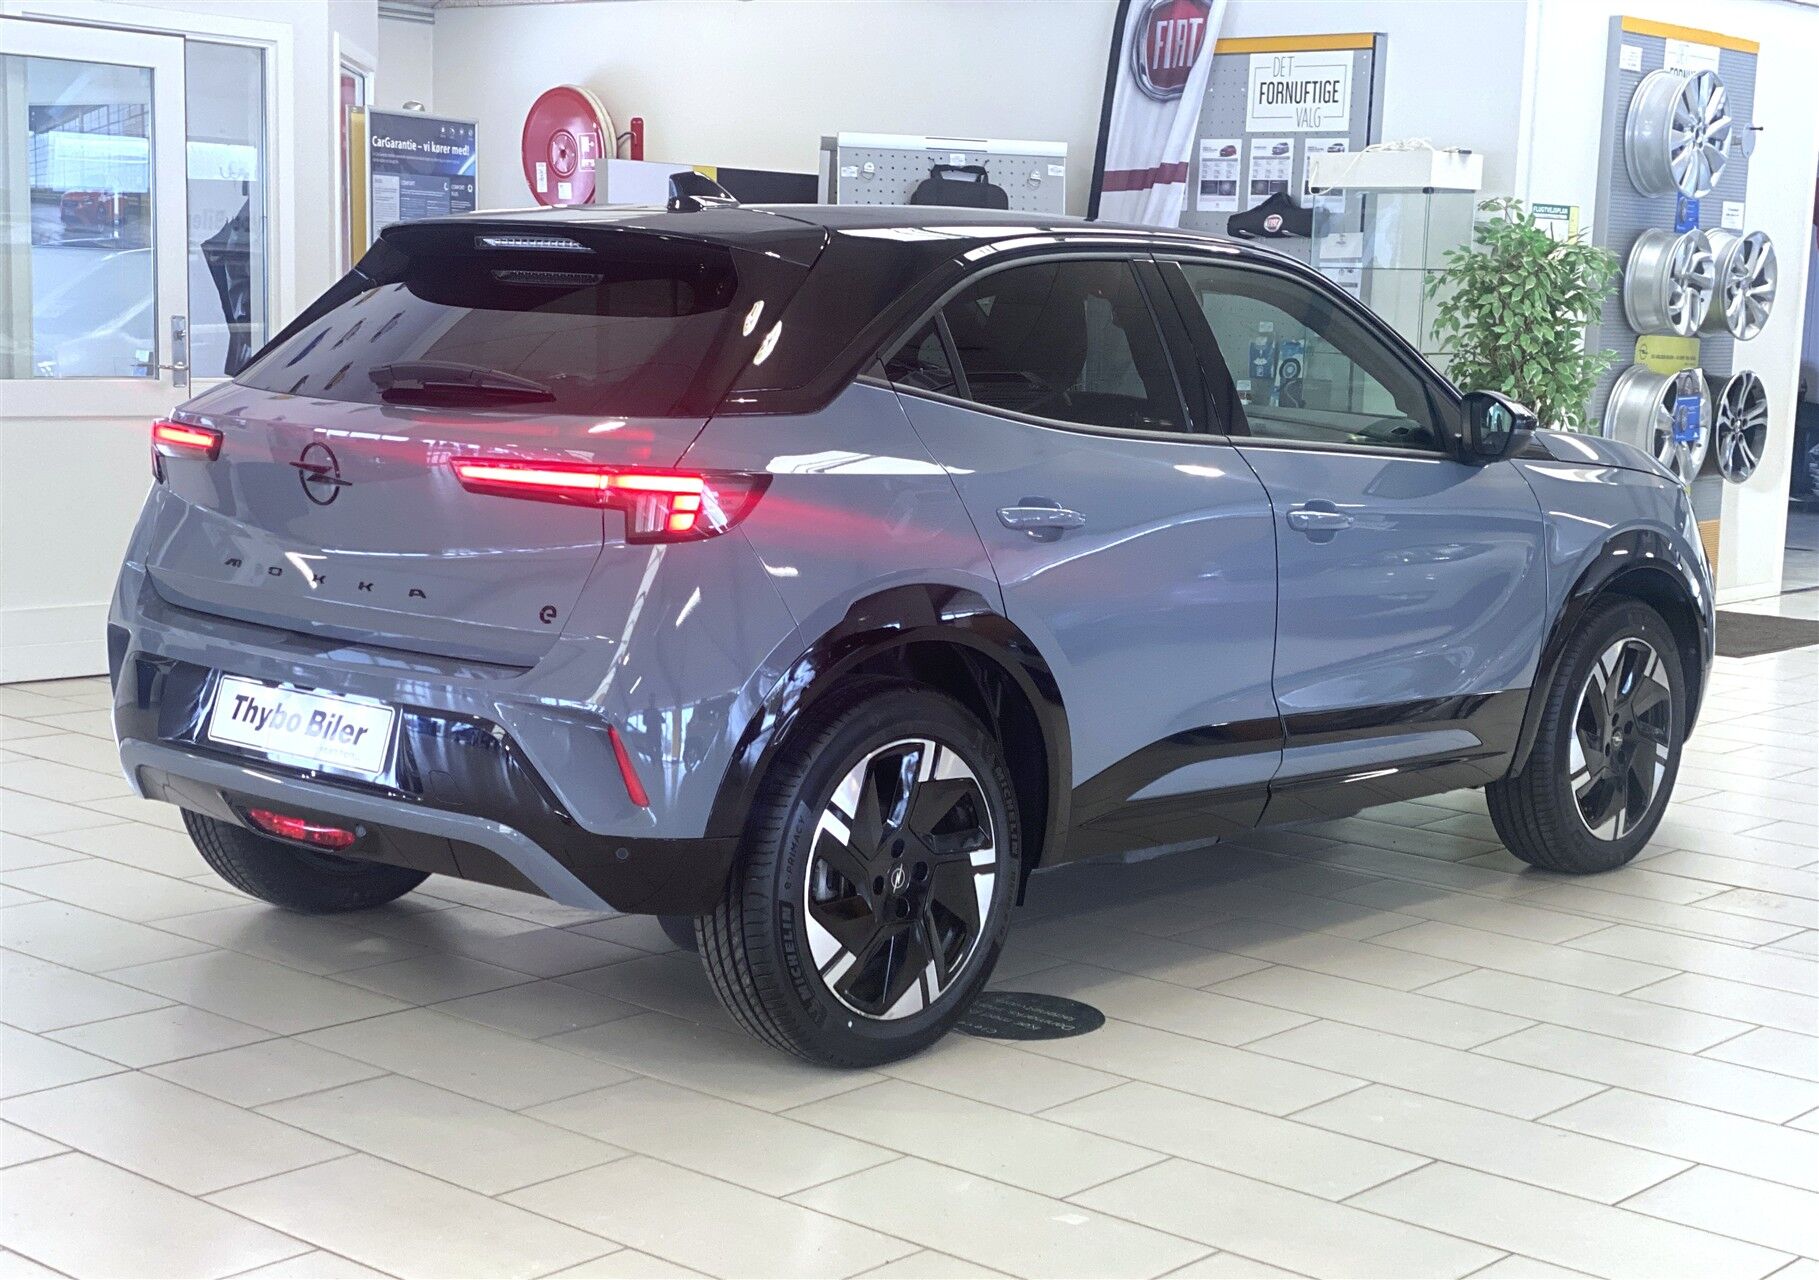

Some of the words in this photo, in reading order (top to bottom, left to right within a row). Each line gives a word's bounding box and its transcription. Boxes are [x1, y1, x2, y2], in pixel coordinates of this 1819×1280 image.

[1152, 17, 1204, 70] FIAT
[1273, 56, 1295, 77] DET
[1259, 80, 1340, 104] FORNUFTIGE
[1296, 107, 1321, 128] VALG
[371, 135, 417, 151] CarGarantie
[423, 141, 431, 152] vi
[431, 141, 451, 154] kører
[451, 144, 470, 156] med!
[224, 557, 427, 599] MOKKA
[231, 694, 302, 732] Thybo
[304, 709, 369, 746] Biler
